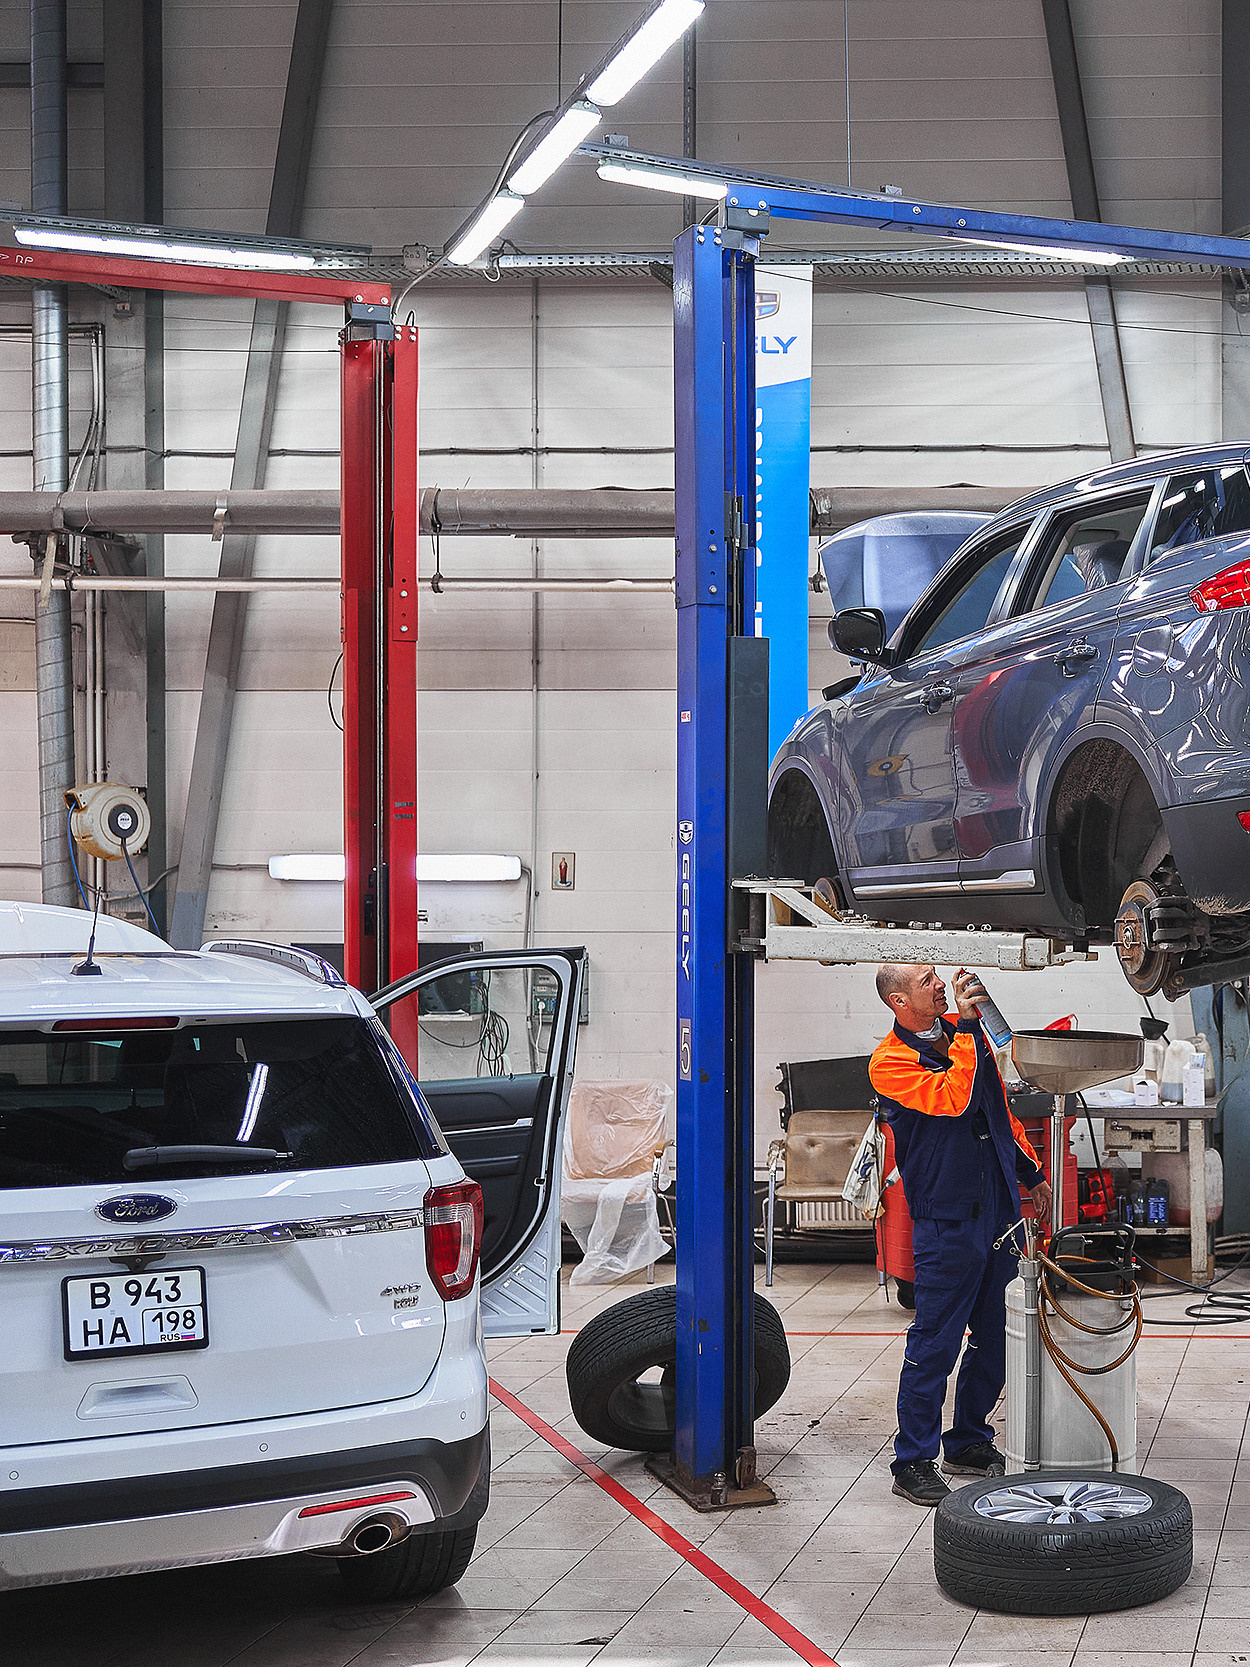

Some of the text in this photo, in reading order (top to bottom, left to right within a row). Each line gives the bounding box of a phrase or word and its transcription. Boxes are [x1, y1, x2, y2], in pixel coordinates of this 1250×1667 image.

[682, 853, 690, 981] GEELY
[680, 1026, 691, 1075] 5
[113, 1197, 161, 1218] Ford
[123, 1275, 182, 1307] 943
[151, 1309, 196, 1333] 198
[160, 1332, 181, 1342] RUS
